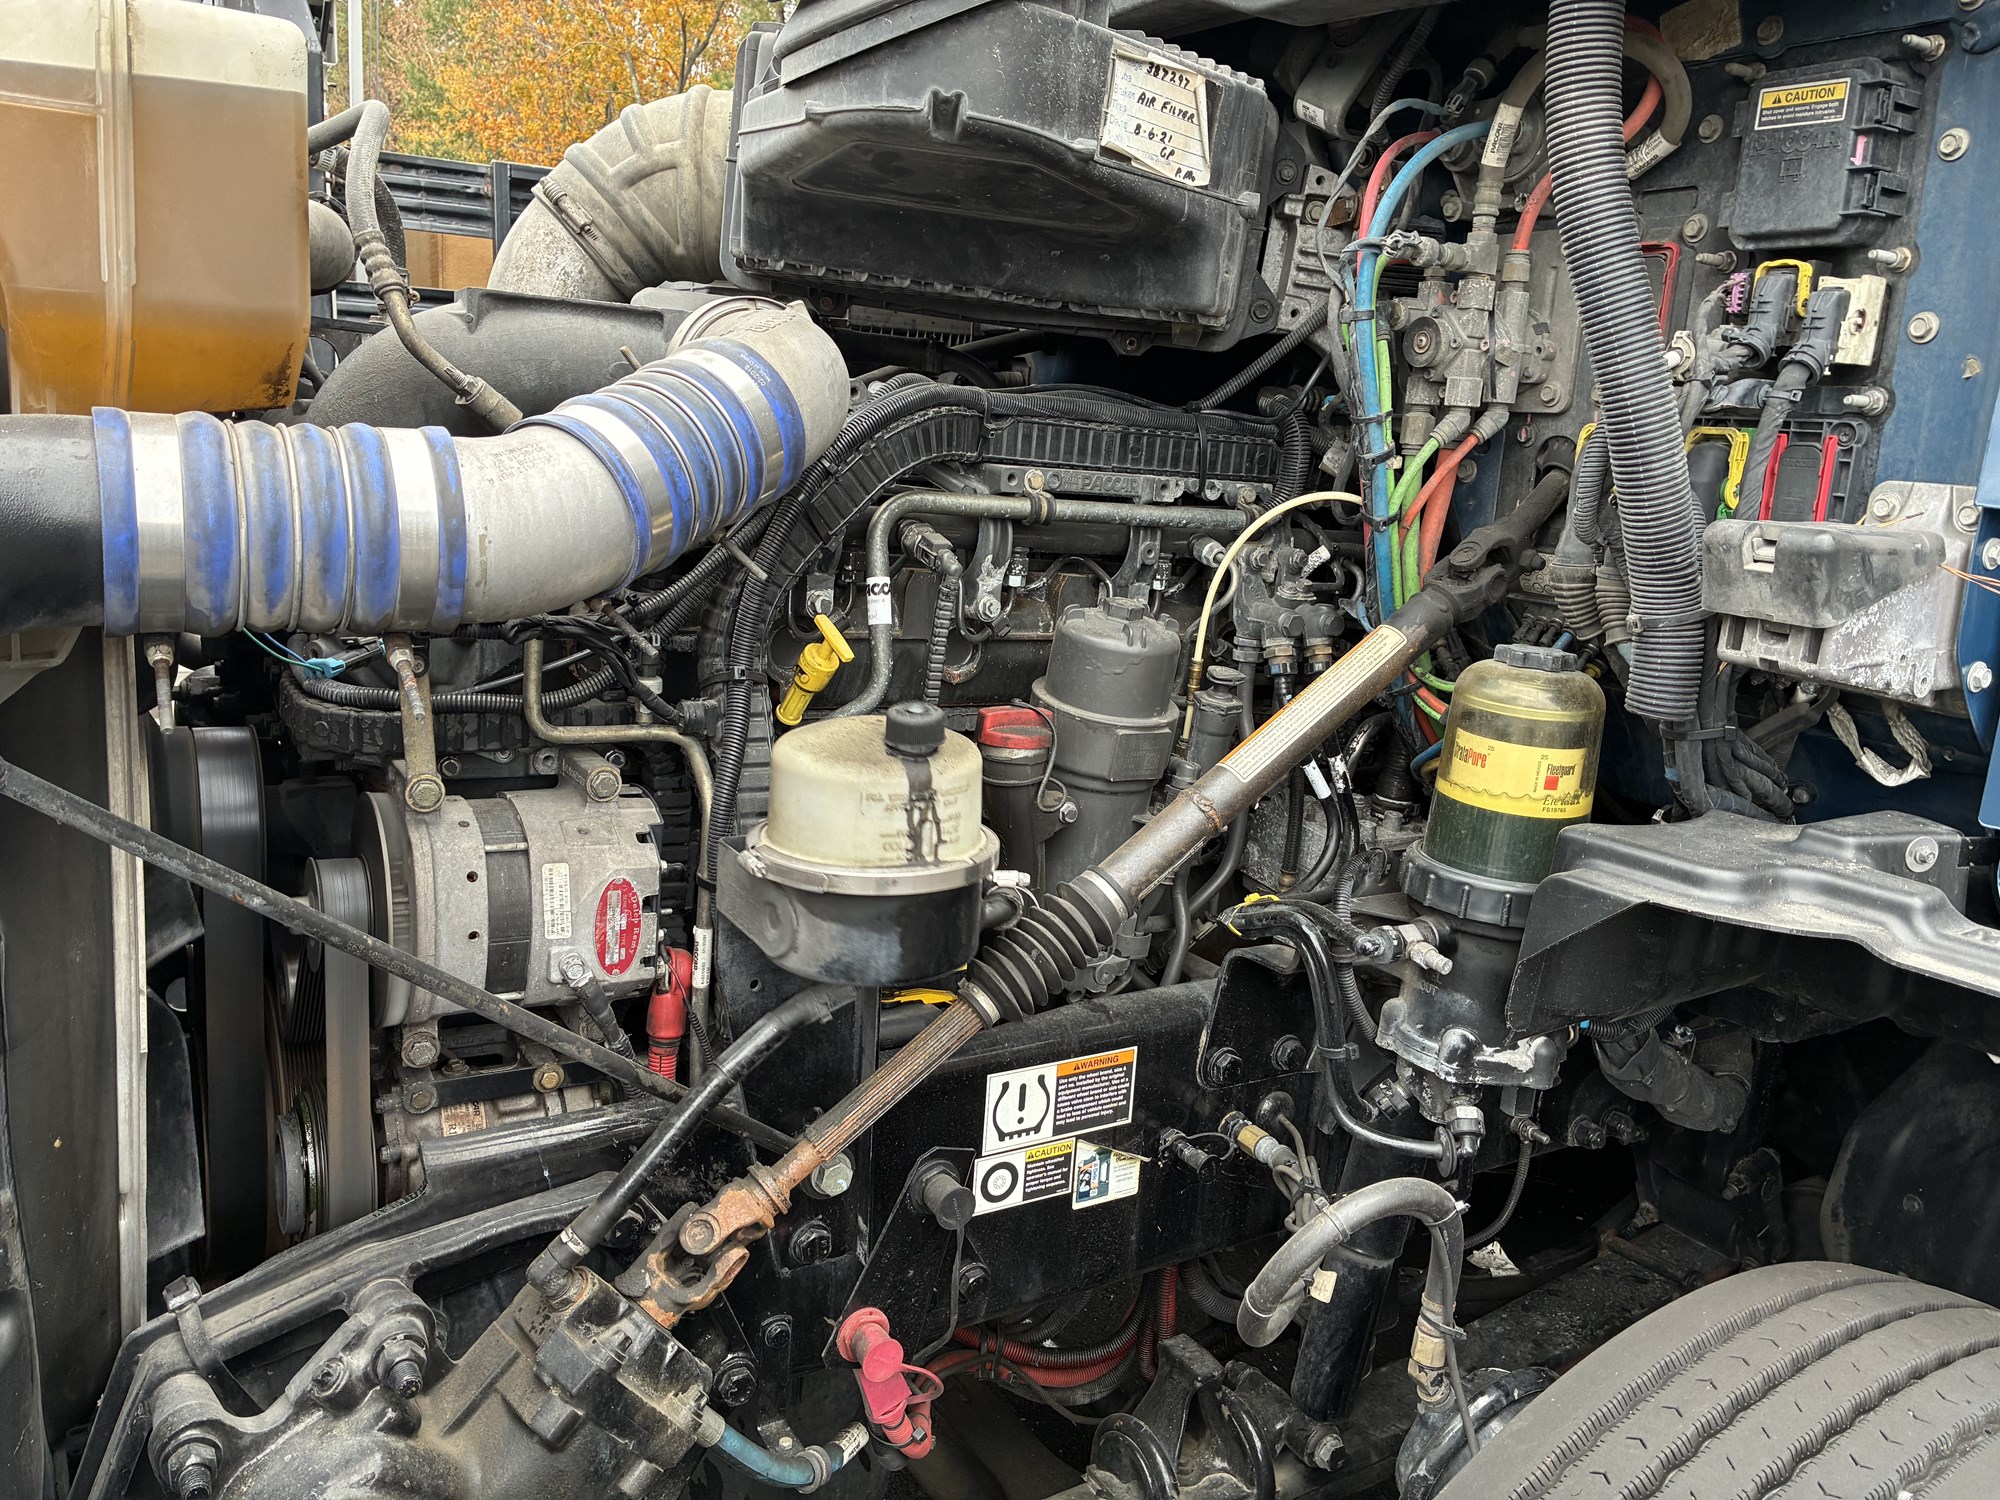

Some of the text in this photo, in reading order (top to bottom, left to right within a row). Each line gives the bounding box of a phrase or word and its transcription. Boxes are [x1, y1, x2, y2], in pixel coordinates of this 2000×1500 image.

[1146, 62, 1191, 89] 387297
[1785, 87, 1836, 103] CAUTION
[1137, 92, 1196, 123] AIR FILTER
[1489, 121, 1503, 154] PACCAR
[1080, 473, 1140, 494] PACCAR
[1546, 762, 1576, 778] Fleetguard
[627, 927, 641, 955] Remy
[1418, 979, 1440, 996] OUT
[1080, 1055, 1119, 1069] WARNING
[1035, 1144, 1072, 1158] CAUTION
